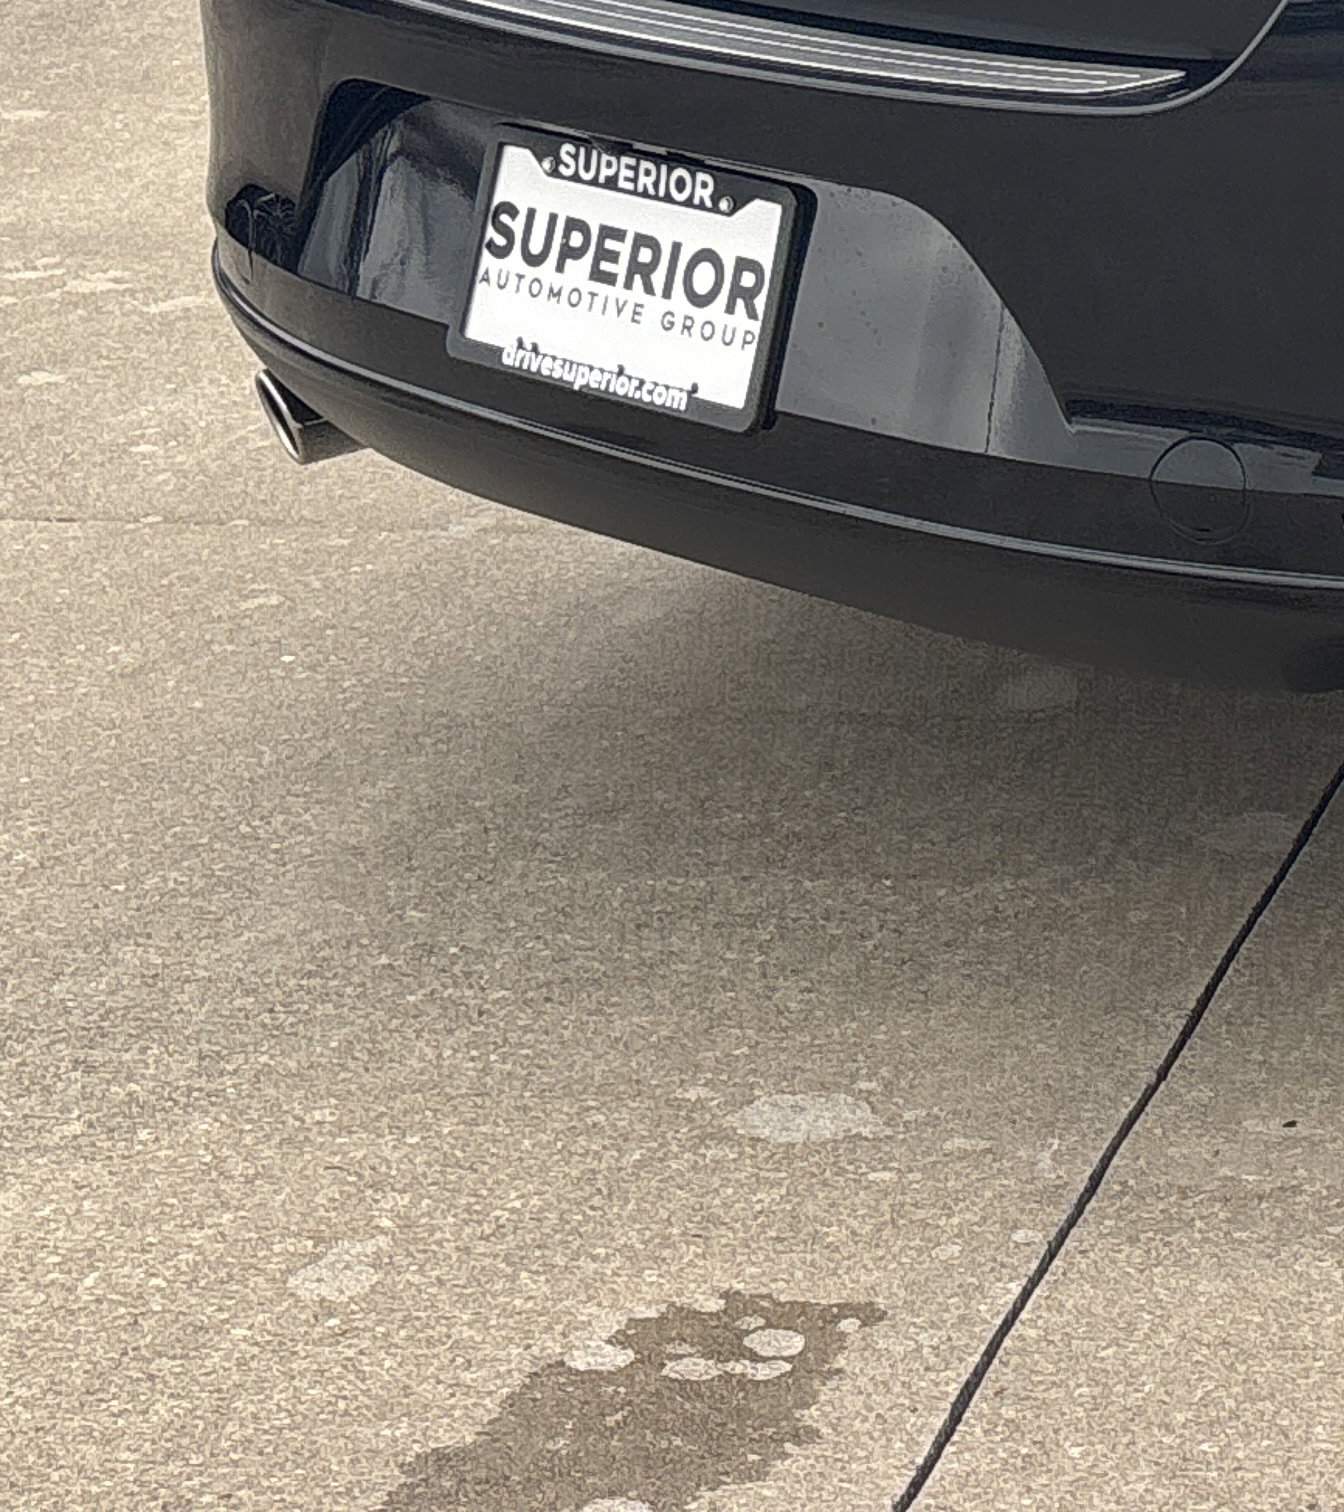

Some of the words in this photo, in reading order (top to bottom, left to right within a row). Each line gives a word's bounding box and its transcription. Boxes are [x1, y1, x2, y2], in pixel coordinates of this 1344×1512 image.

[557, 142, 715, 209] SUPERIOR
[484, 200, 766, 322] SUPERIOR
[478, 266, 645, 325] AUTOMOTIVE
[660, 310, 757, 351] GROUP
[501, 343, 689, 411] drivesuperior.com
